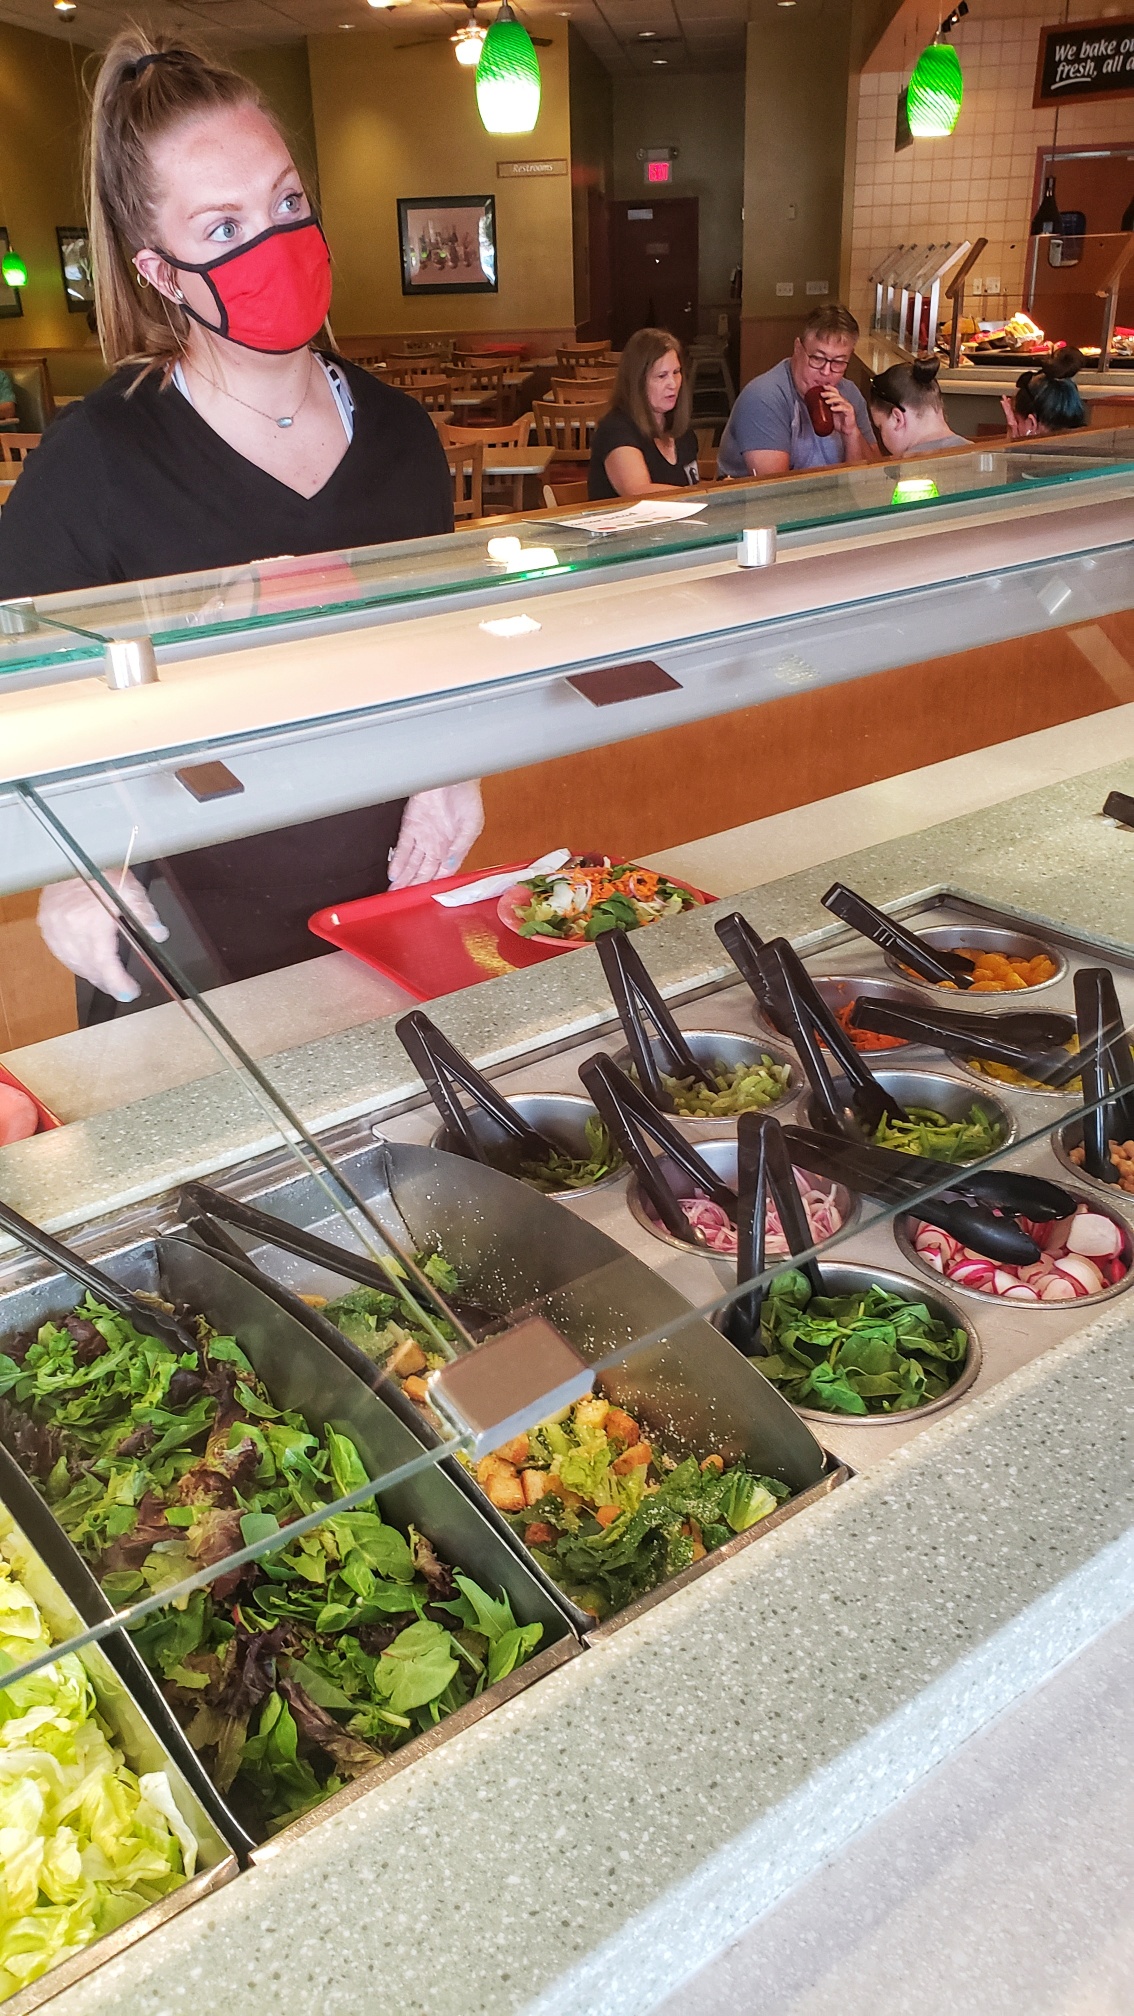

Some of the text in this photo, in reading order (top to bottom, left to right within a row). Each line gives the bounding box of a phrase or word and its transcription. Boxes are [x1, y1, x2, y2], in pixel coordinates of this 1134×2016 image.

[1055, 44, 1077, 62] We
[1080, 39, 1117, 58] bake
[1056, 59, 1098, 82] fresh,
[1102, 55, 1124, 73] all
[512, 164, 553, 173] Restrooms
